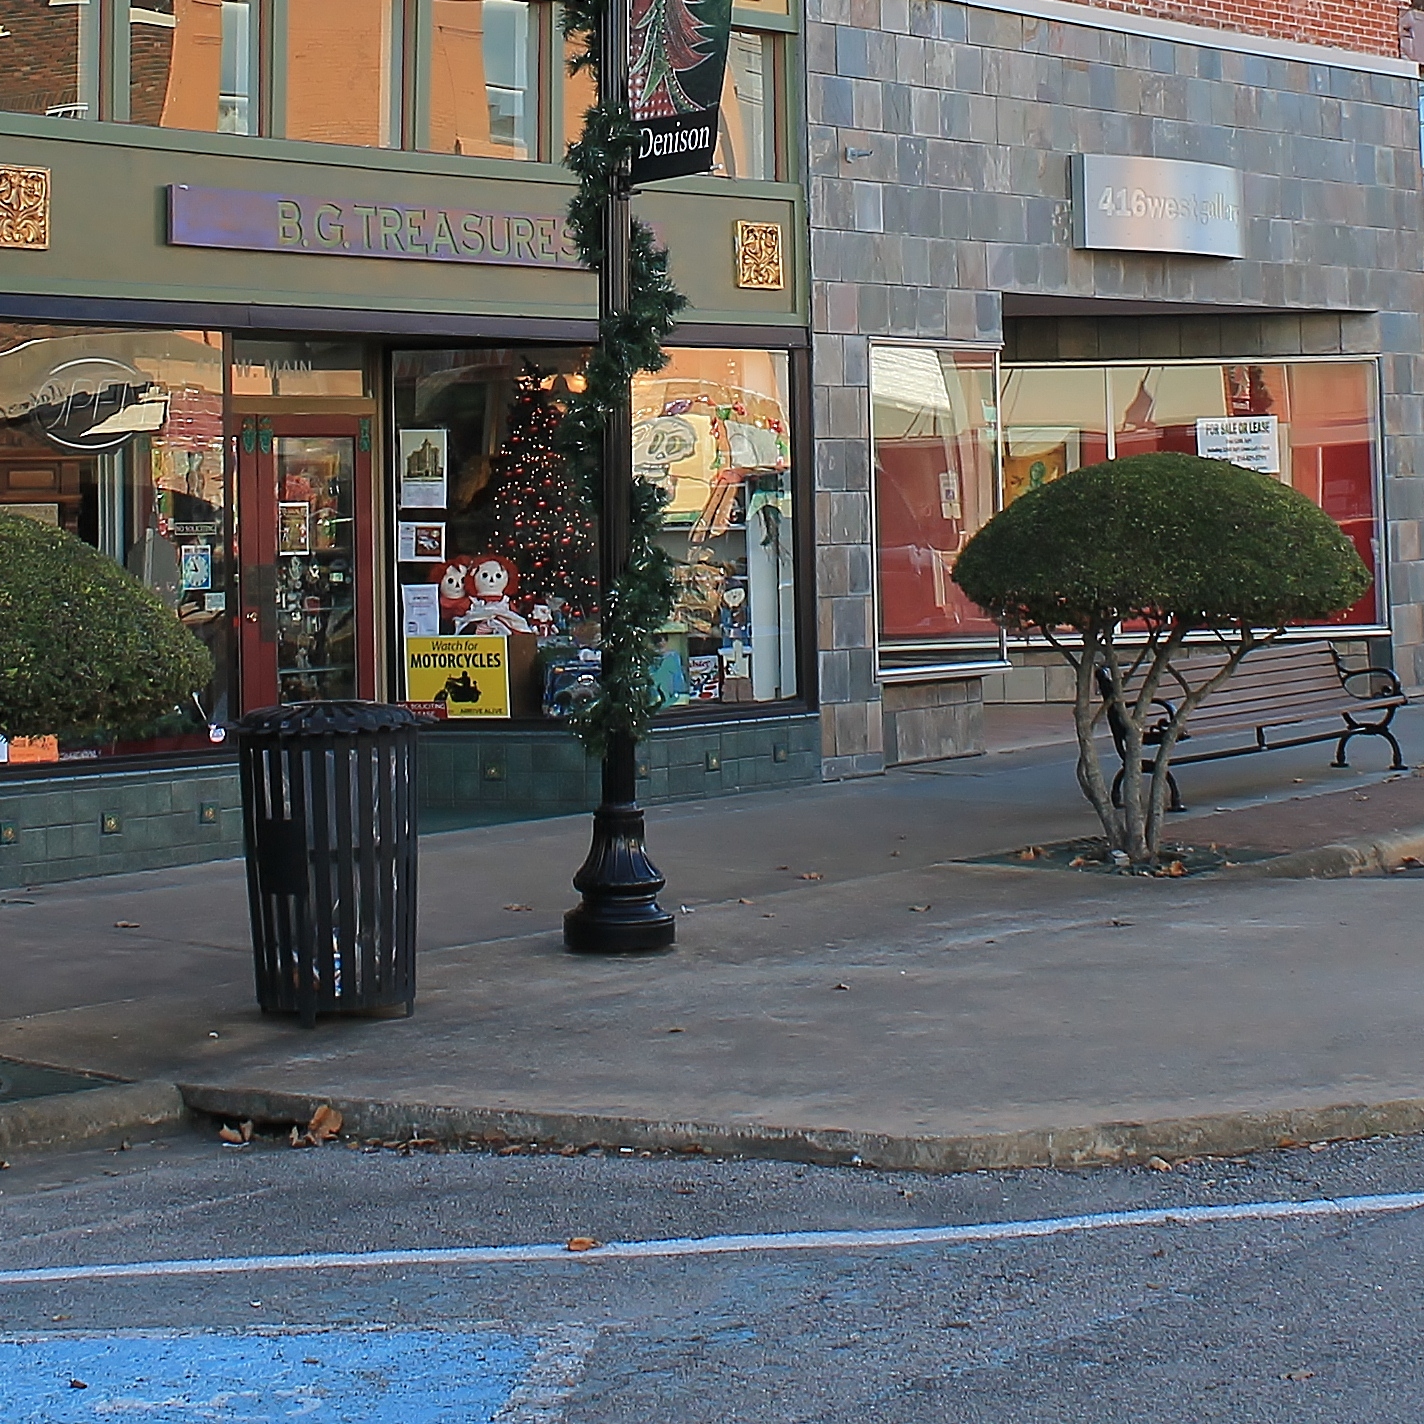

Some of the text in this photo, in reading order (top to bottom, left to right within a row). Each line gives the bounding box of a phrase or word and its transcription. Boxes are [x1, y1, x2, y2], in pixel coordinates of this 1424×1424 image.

[638, 121, 710, 159] Denison
[353, 204, 580, 263] TREASURES
[264, 358, 313, 379] MAIN
[1249, 421, 1271, 434] LEASE
[431, 640, 478, 651] Watch for
[410, 653, 501, 668] MOTORCYCLES
